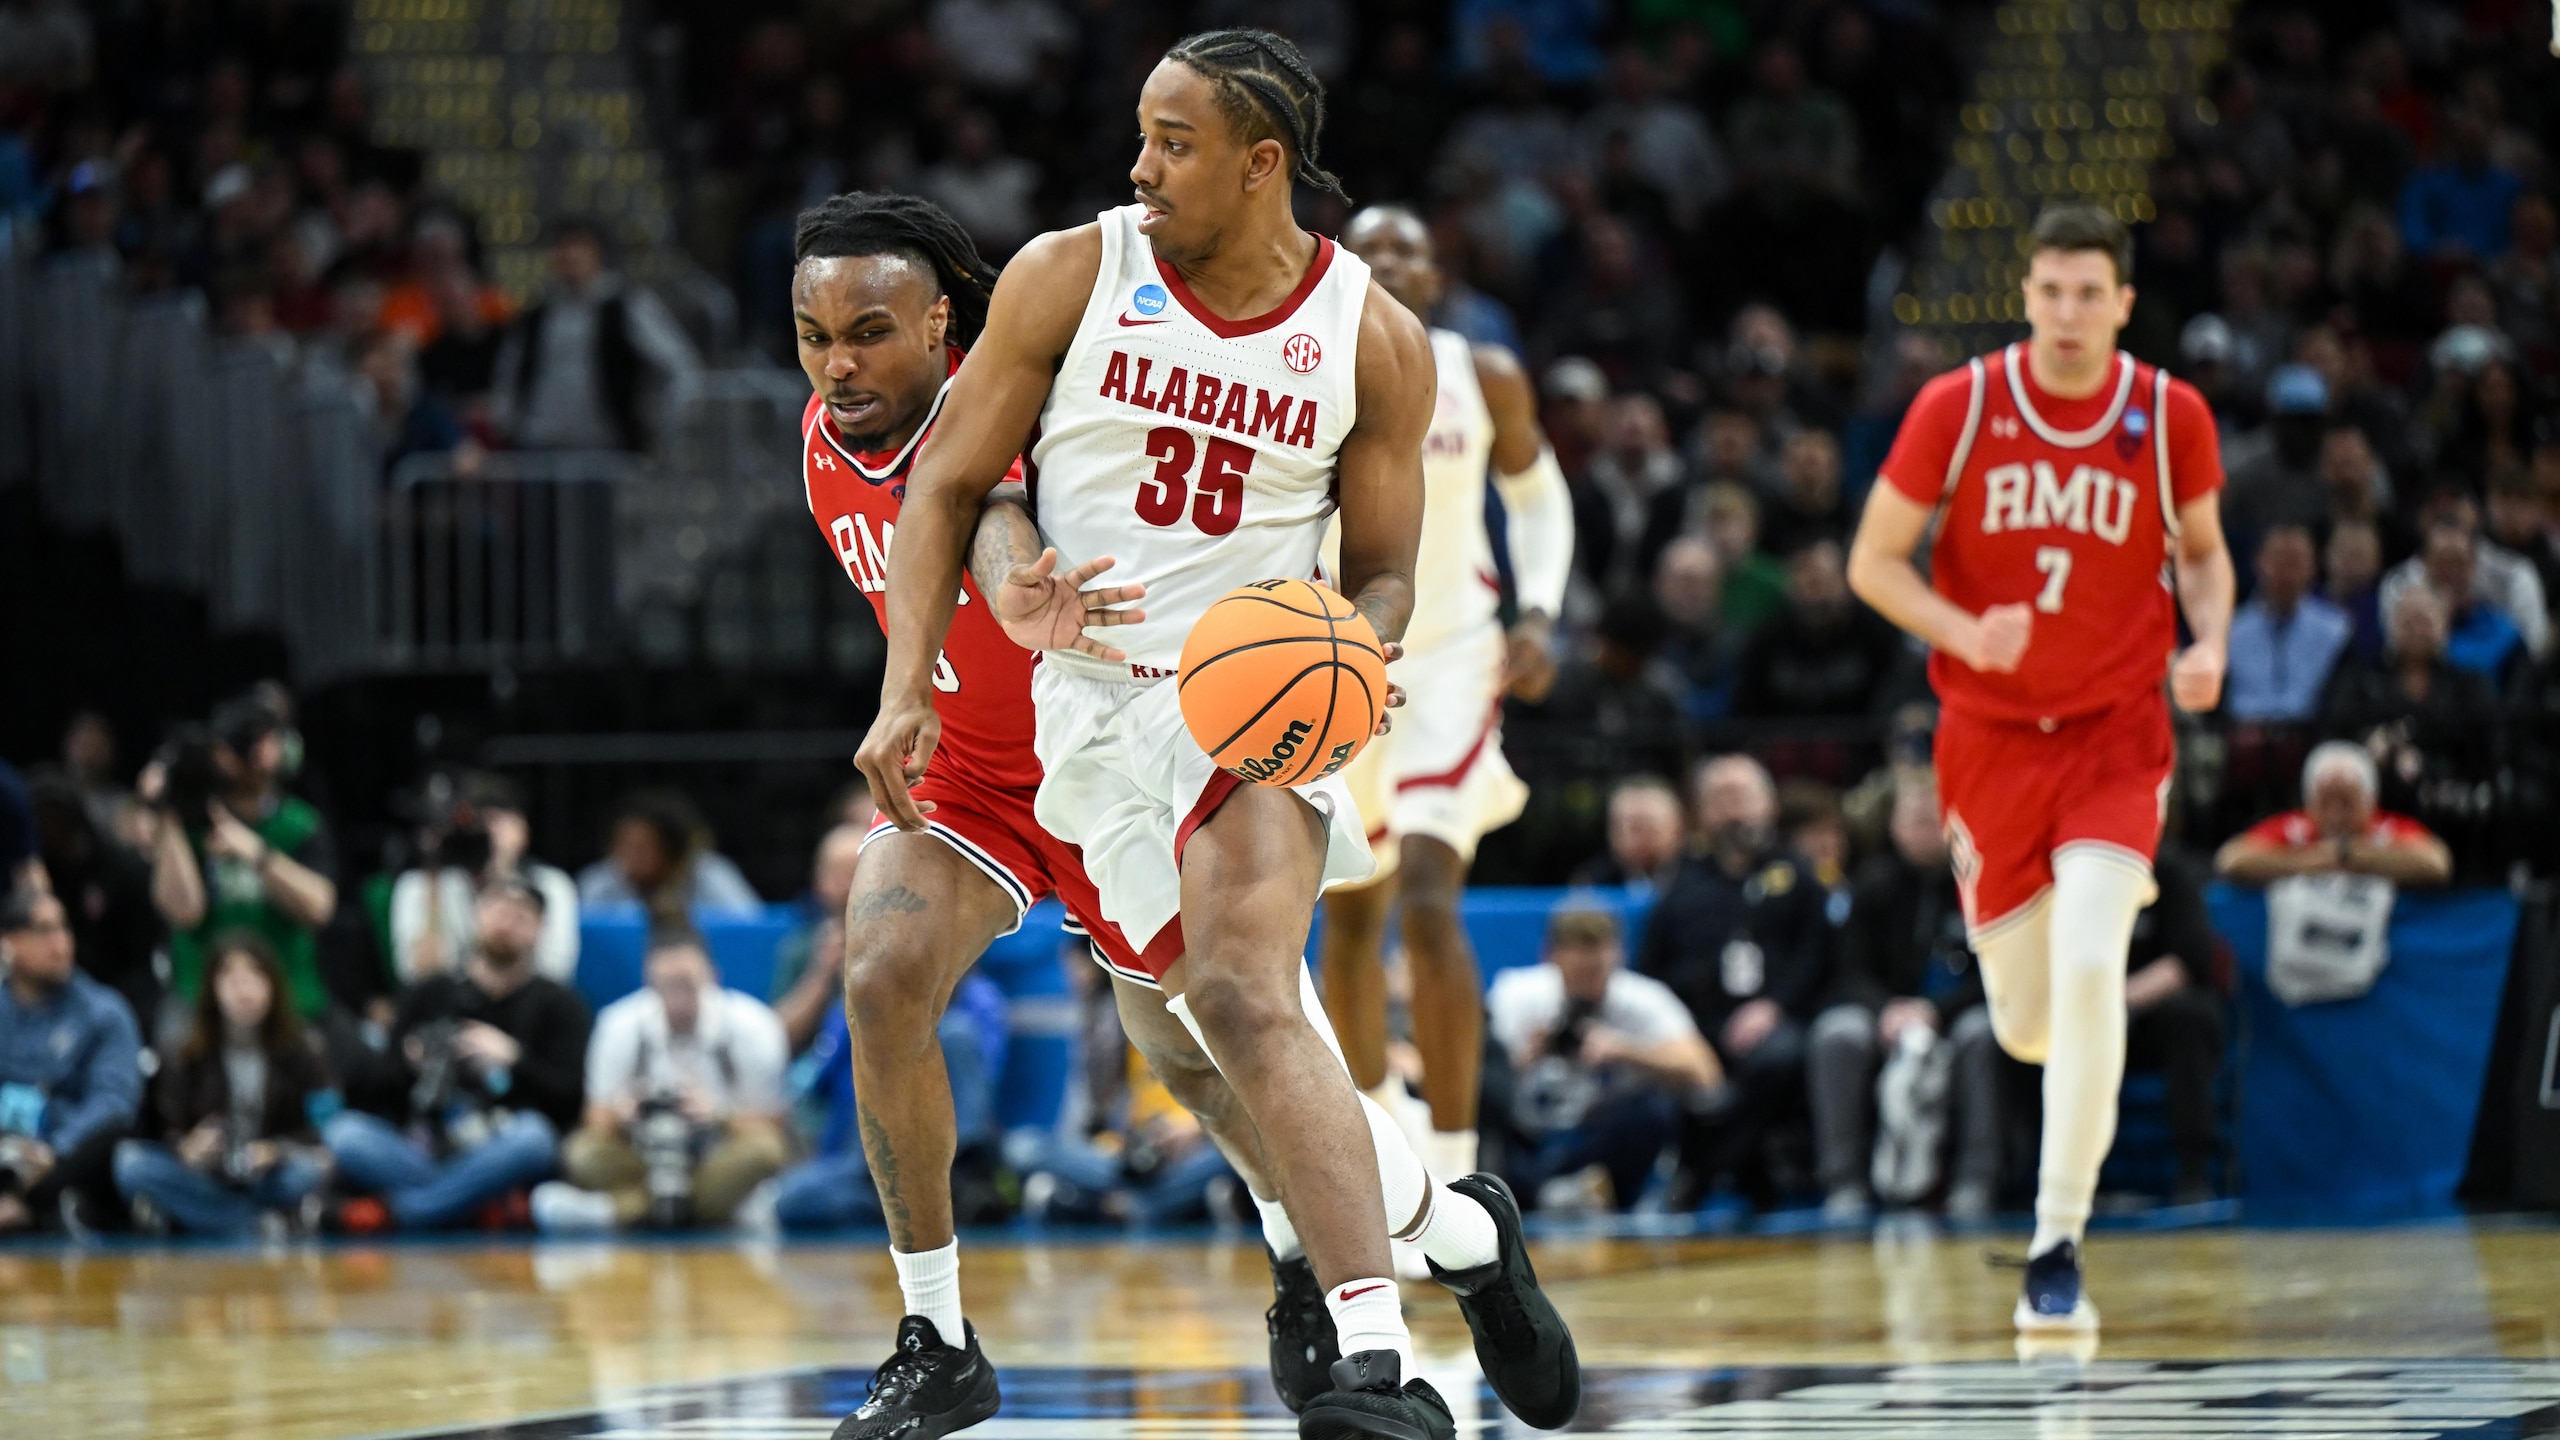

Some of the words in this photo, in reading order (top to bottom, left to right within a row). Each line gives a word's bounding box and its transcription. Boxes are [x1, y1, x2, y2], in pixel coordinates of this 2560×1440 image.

[1136, 295, 1163, 309] NCAA
[1284, 334, 1321, 372] SEC
[1100, 350, 1318, 449] ALABAMA
[1134, 426, 1257, 536] 35
[1983, 461, 2136, 545] RMU
[830, 513, 895, 592] RM
[2036, 547, 2071, 613] 7
